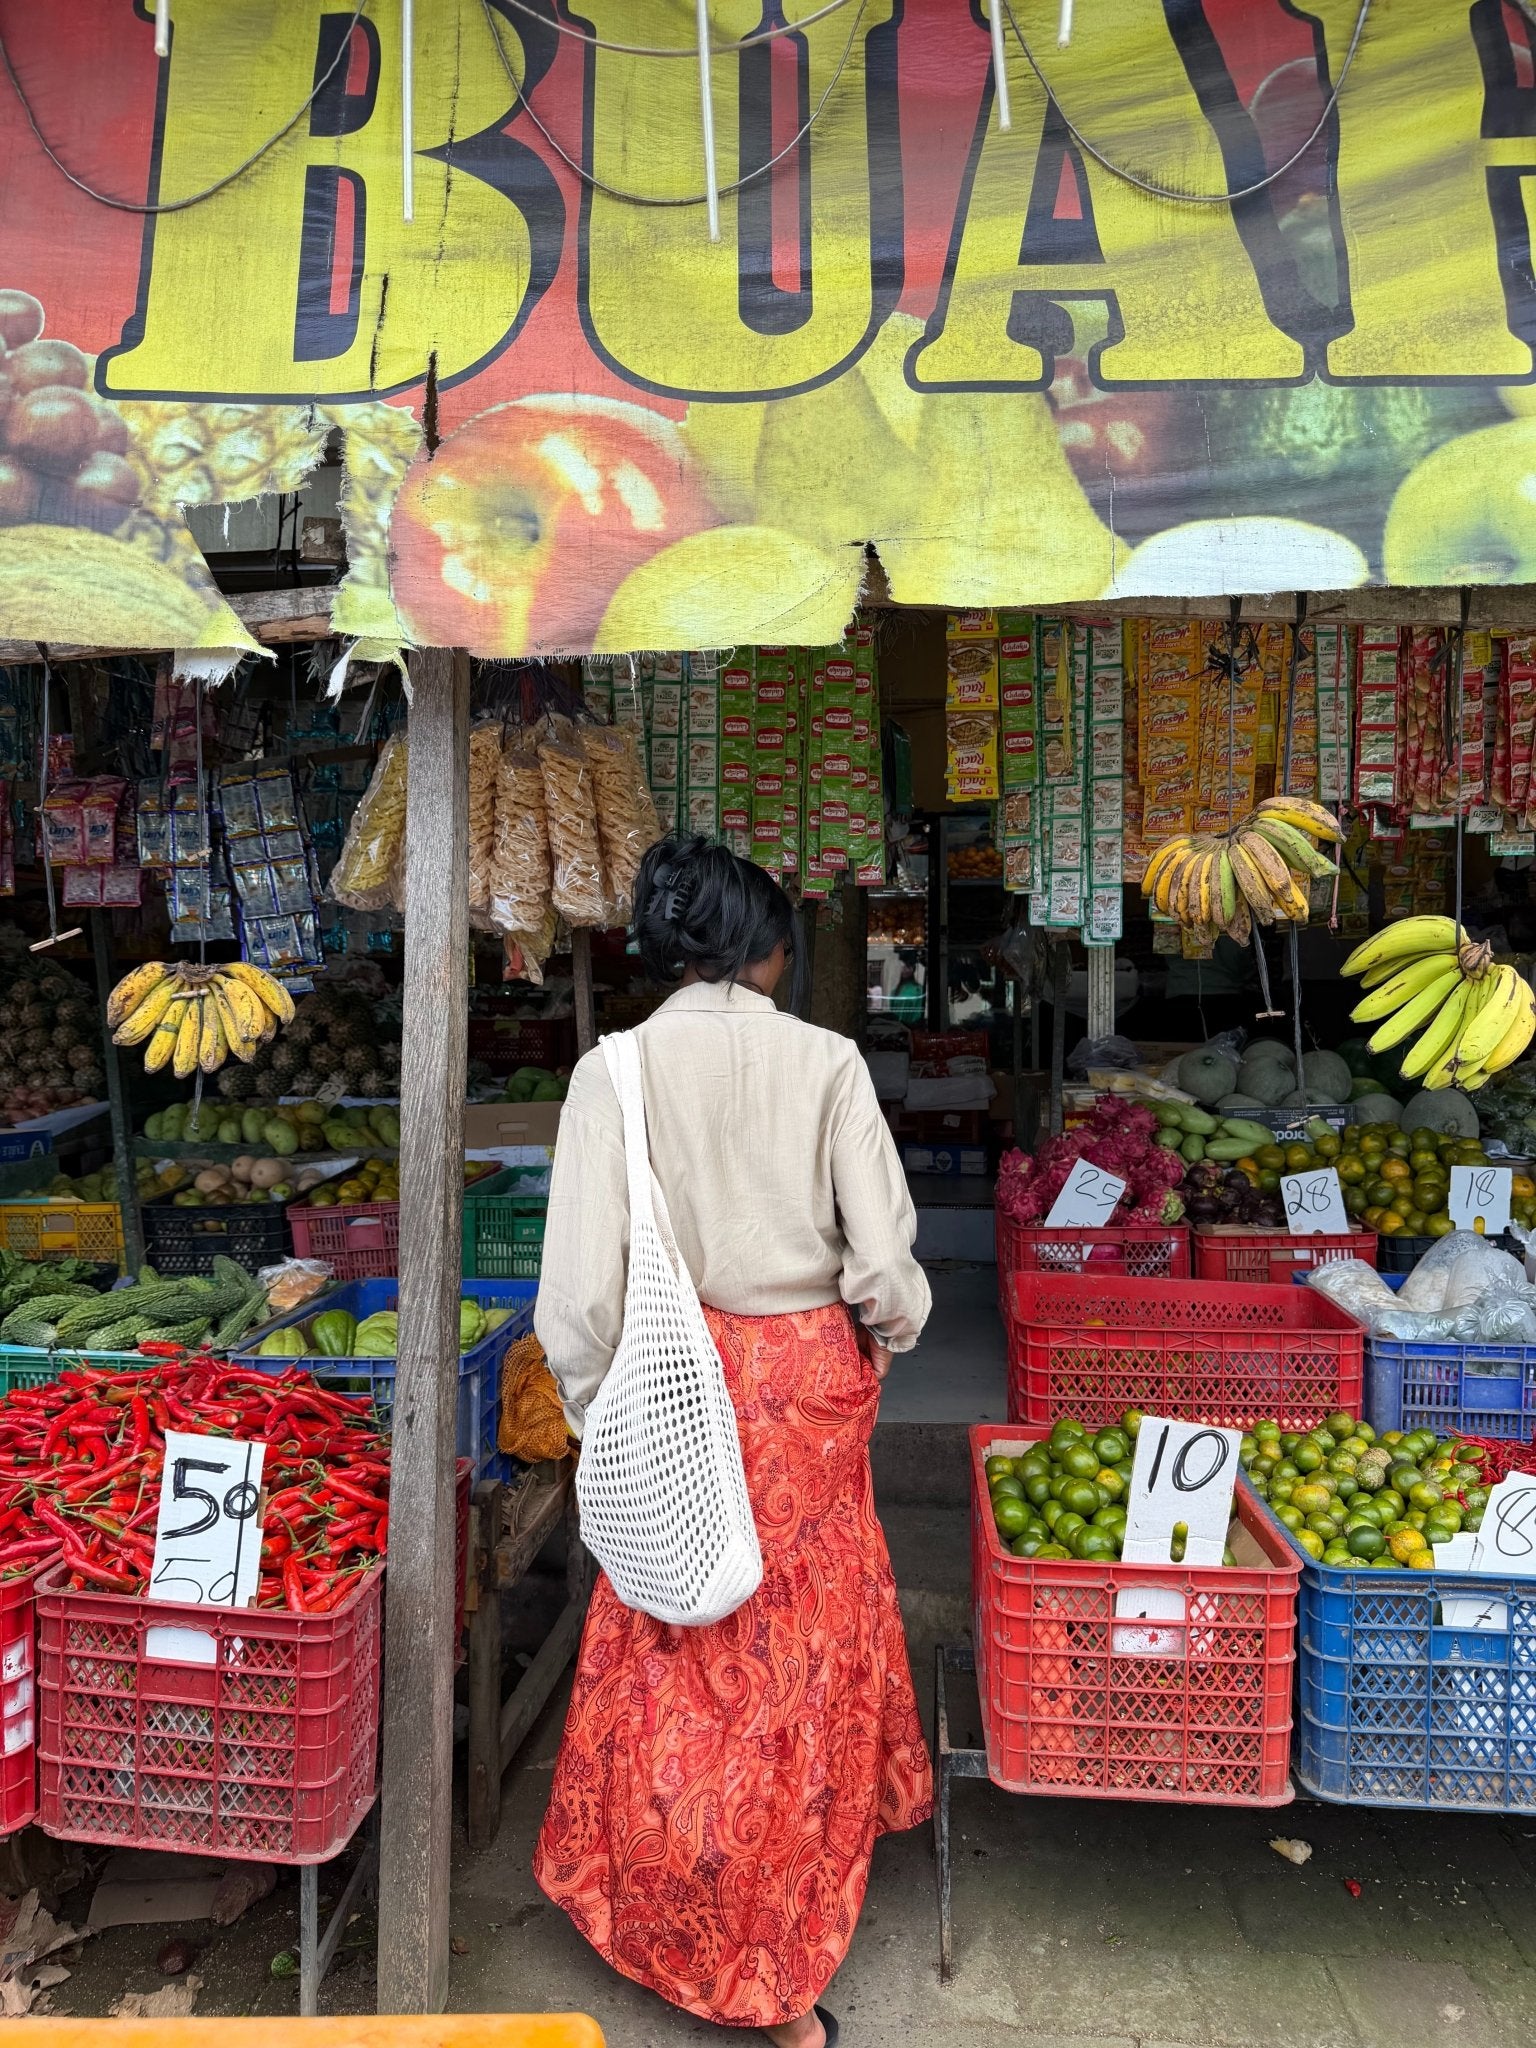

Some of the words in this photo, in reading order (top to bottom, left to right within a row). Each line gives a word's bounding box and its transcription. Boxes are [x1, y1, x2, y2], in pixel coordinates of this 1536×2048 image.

[956, 682, 986, 696] Racik
[955, 753, 984, 767] Racik
[1075, 1169, 1122, 1206] 25
[1286, 1176, 1330, 1215] 28
[1465, 1169, 1496, 1208] 18
[1147, 1425, 1229, 1493] 10
[161, 1457, 259, 1541] 50
